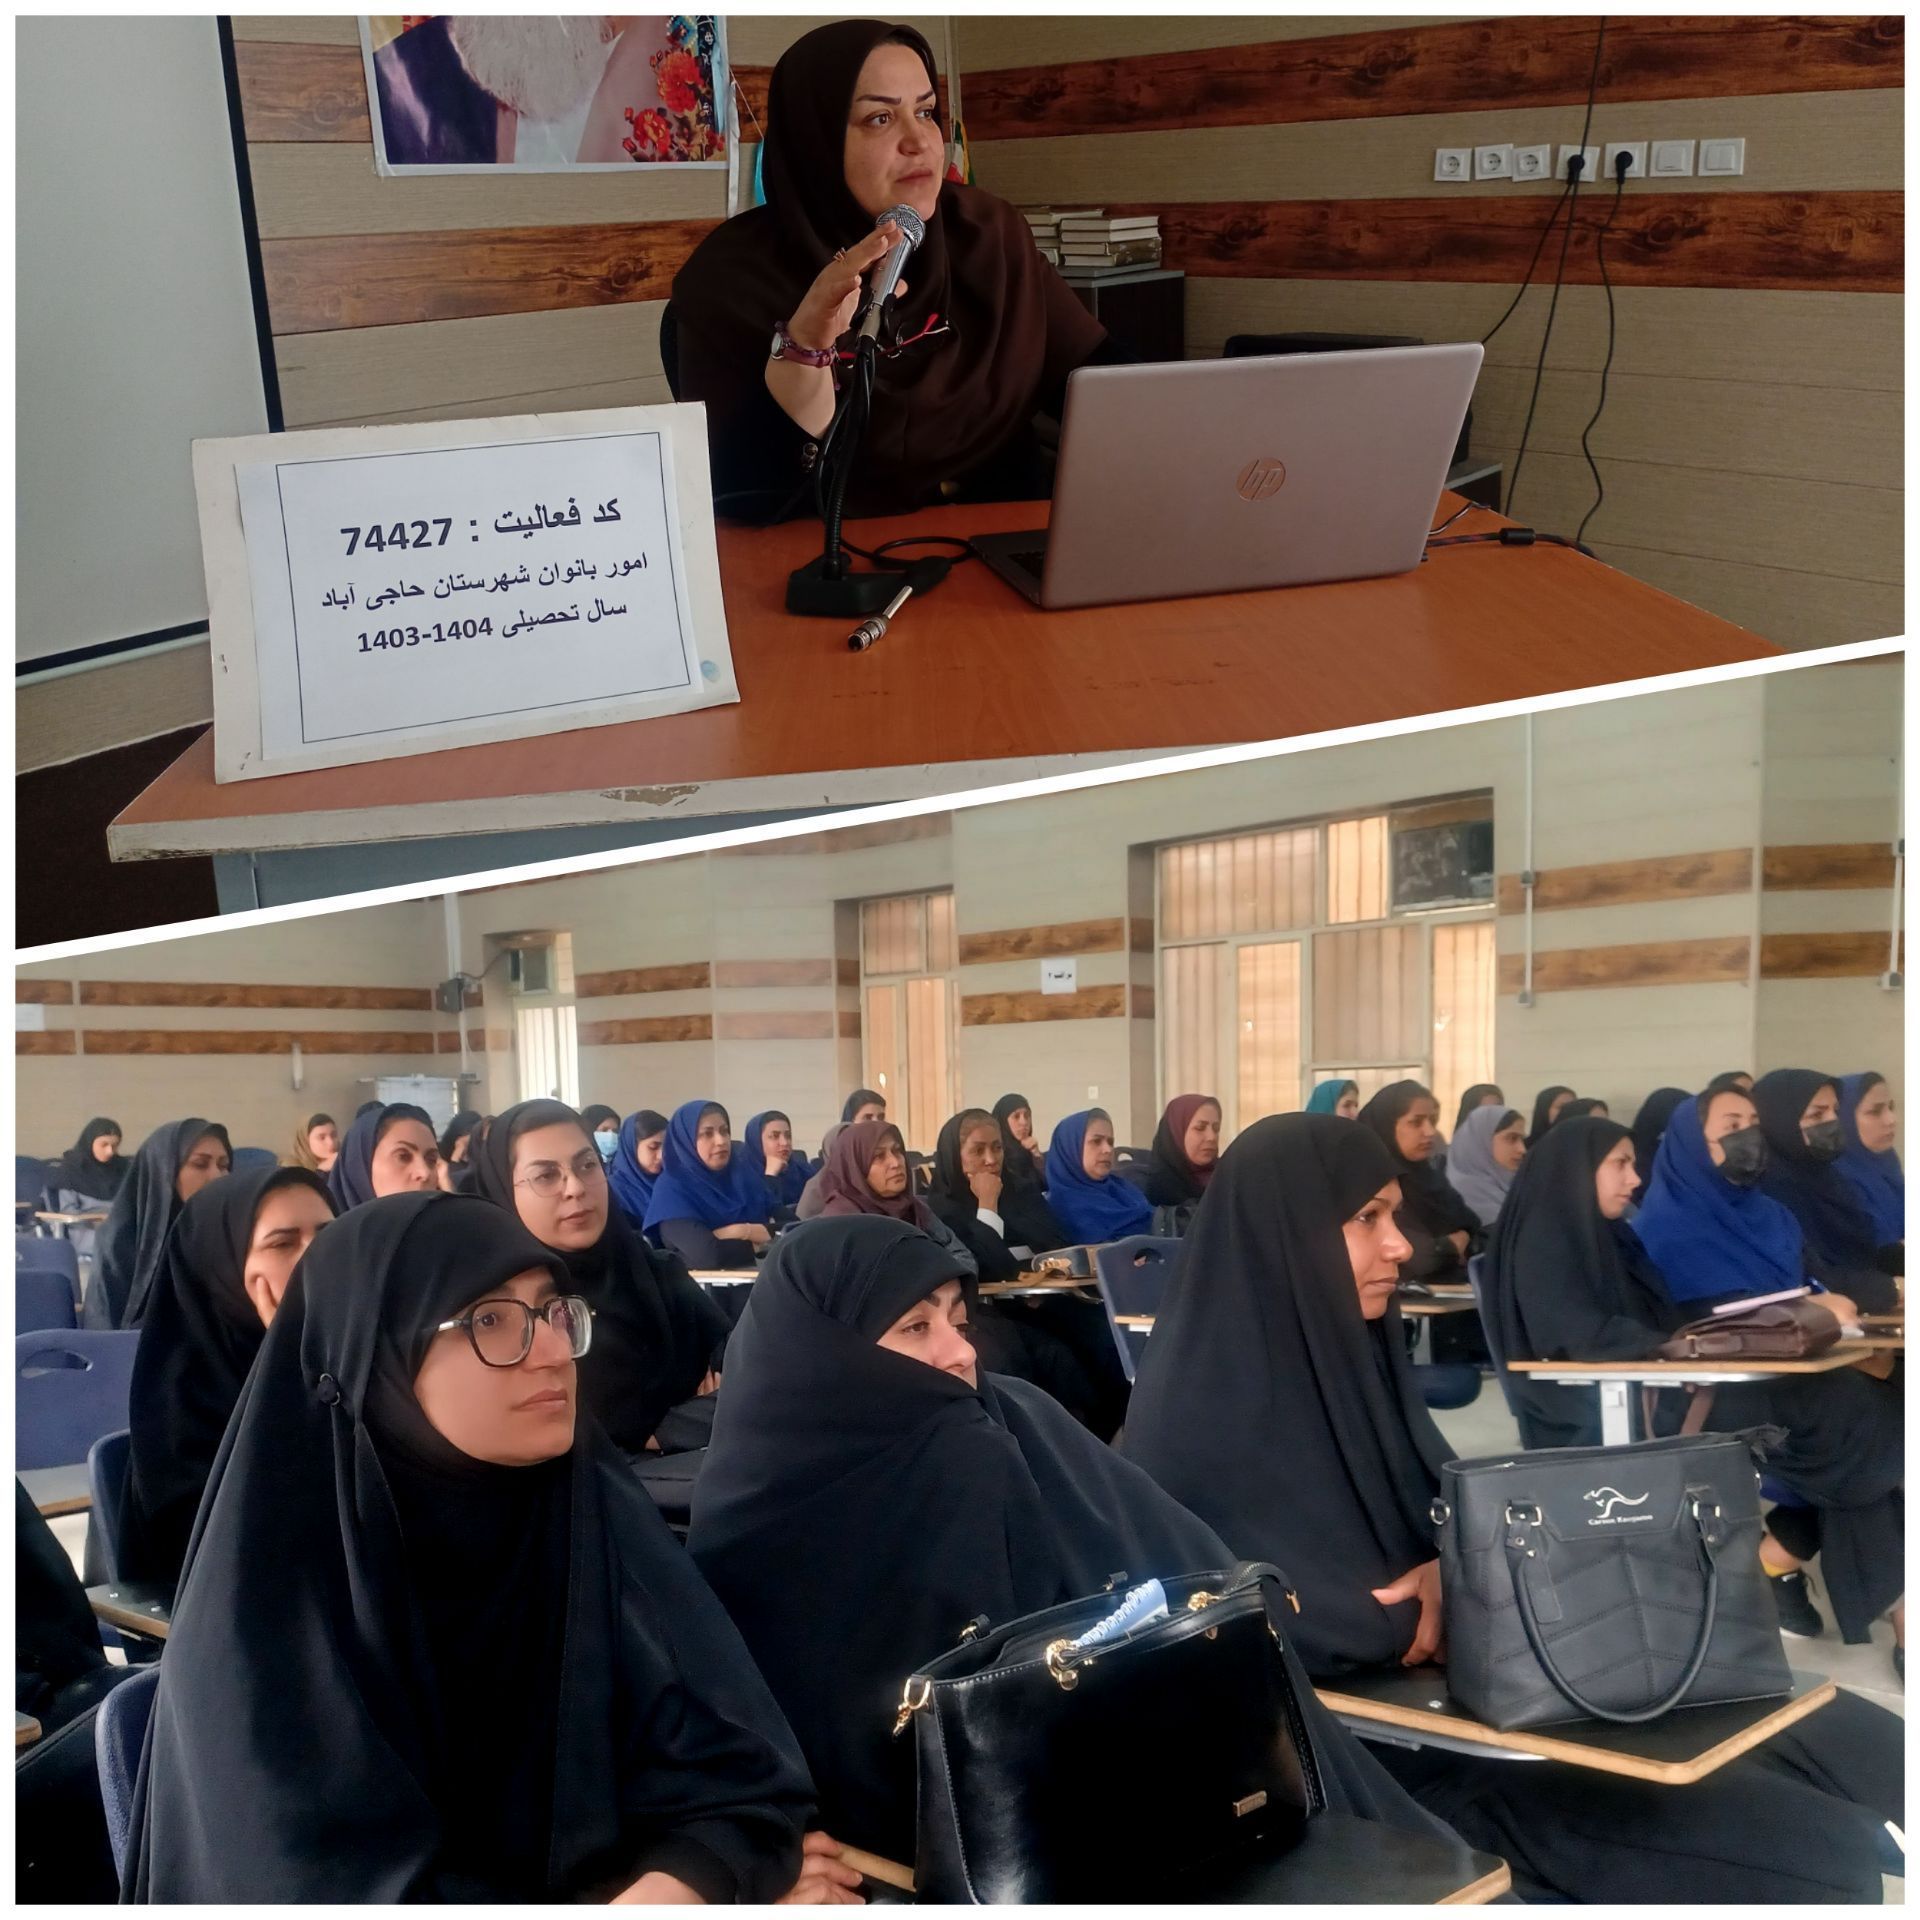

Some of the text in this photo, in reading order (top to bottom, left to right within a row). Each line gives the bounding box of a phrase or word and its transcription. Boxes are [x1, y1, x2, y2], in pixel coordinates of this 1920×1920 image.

[1239, 458, 1283, 501] hp
[339, 496, 622, 556] کد فعالیت : 74427
[321, 551, 648, 611] امور بانوان شهرستان حاجی آباد
[357, 597, 628, 653] سال تحصیلی 1403-1404
